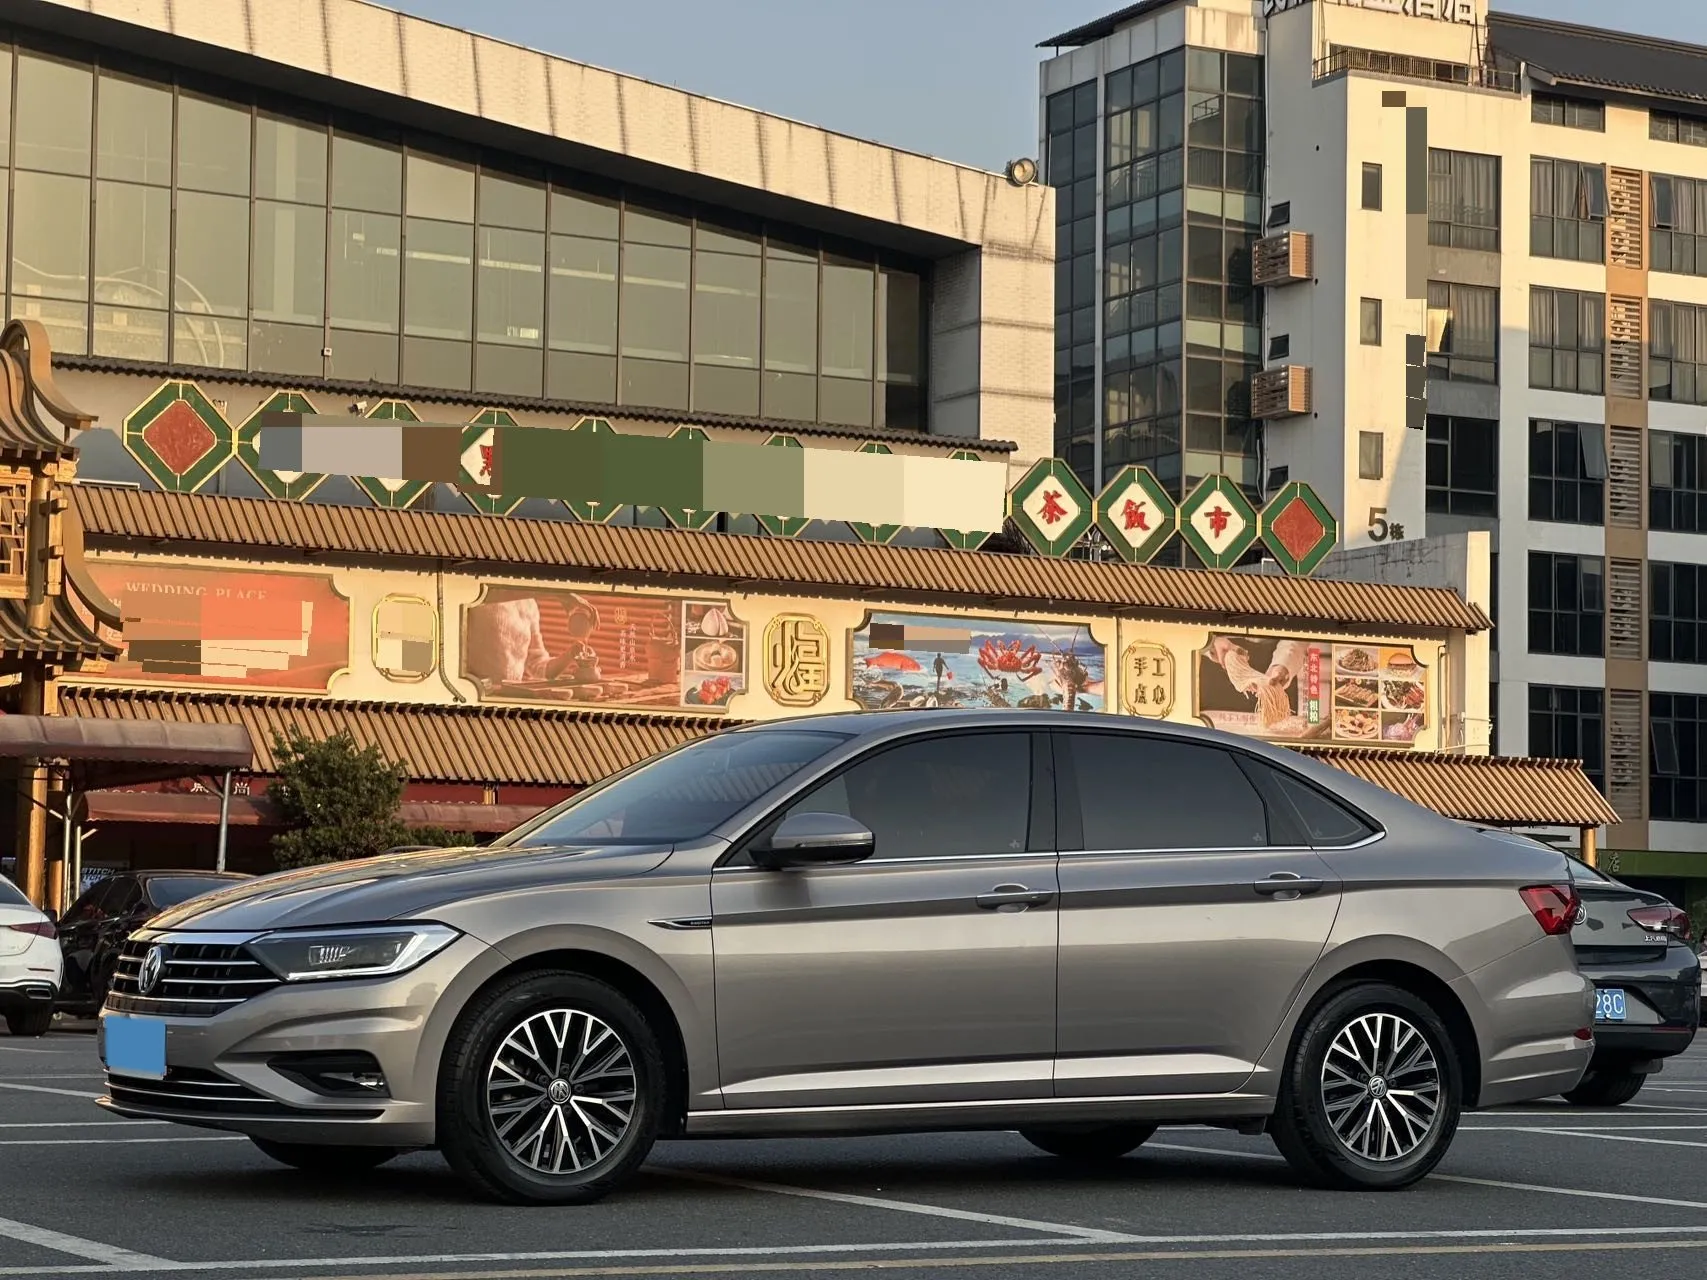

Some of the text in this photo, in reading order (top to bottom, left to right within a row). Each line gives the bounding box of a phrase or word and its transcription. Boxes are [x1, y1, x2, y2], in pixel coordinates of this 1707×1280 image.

[1367, 506, 1405, 542] 5栋
[125, 582, 267, 600] WEDDING PLACE
[1133, 655, 1167, 678] 手工
